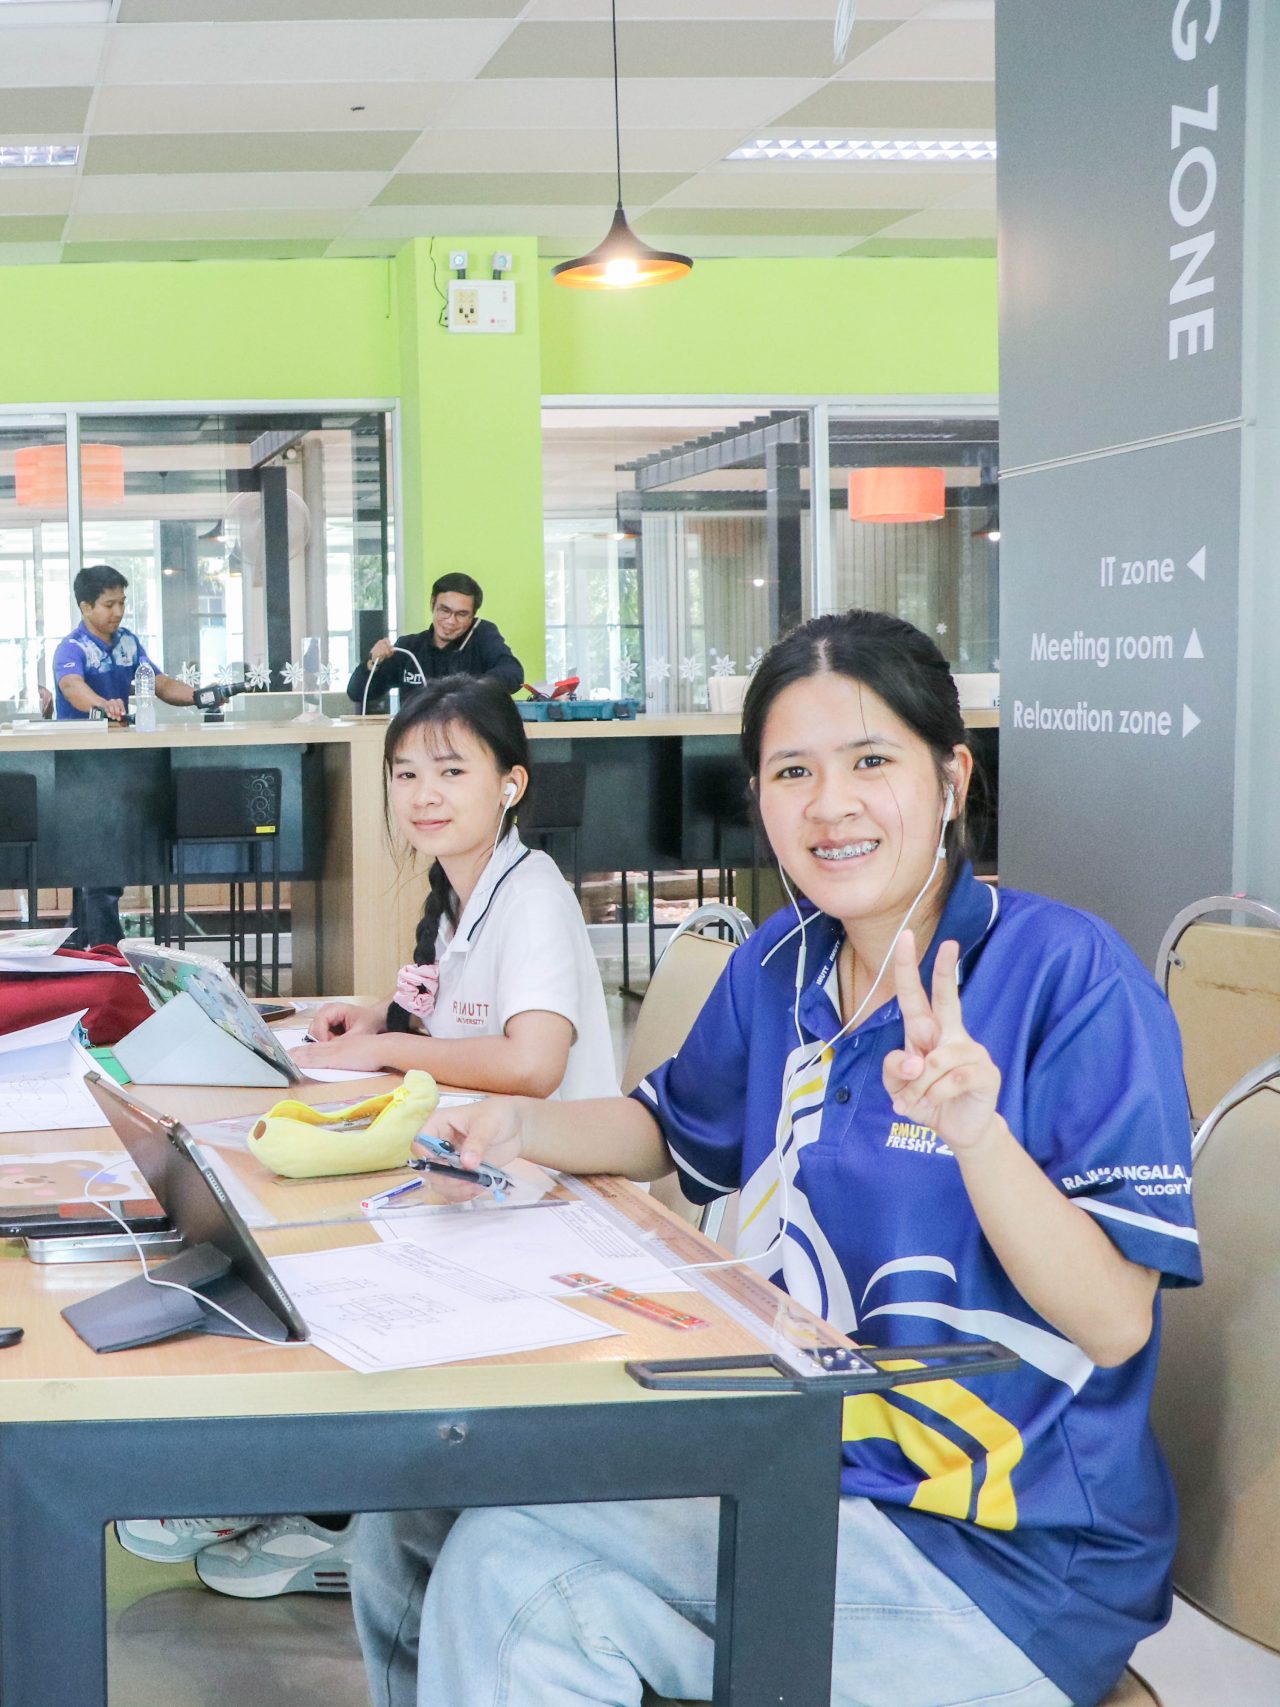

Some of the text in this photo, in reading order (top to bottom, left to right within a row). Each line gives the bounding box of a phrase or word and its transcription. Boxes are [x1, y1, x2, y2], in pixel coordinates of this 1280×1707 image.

[1169, 84, 1218, 361] ZONE
[1100, 556, 1175, 587] IT zone
[1030, 630, 1173, 668] Meeting room
[1013, 699, 1172, 736] Relaxation zone
[885, 1135, 937, 1154] FRESHY
